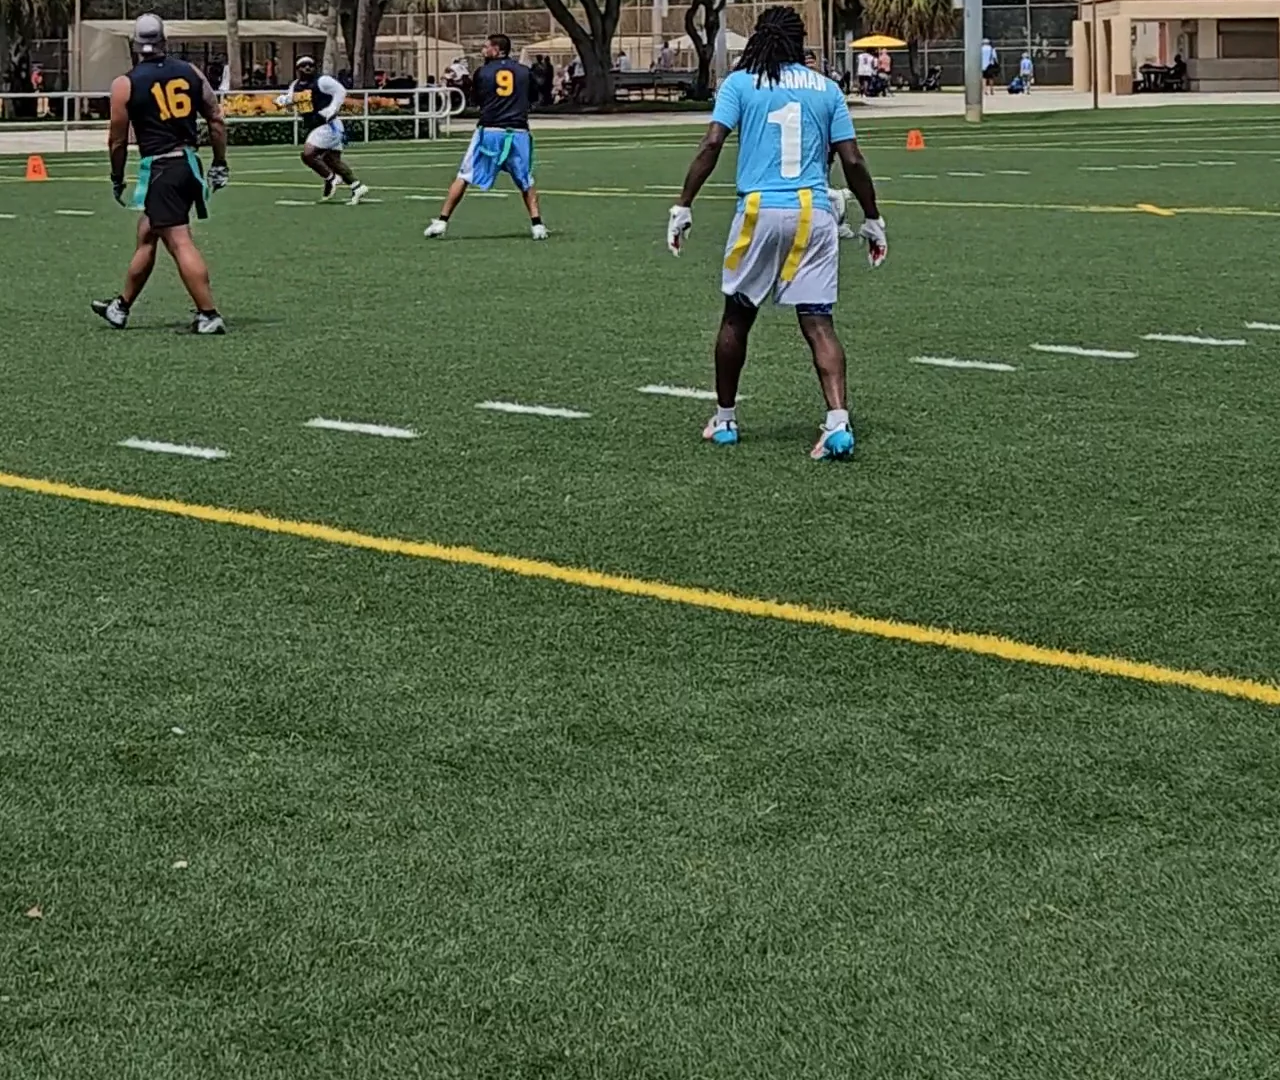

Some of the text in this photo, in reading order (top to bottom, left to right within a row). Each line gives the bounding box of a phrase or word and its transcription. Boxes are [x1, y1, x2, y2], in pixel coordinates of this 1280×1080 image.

[150, 77, 192, 121] 16
[495, 69, 514, 97] 9
[767, 101, 802, 178] 1
